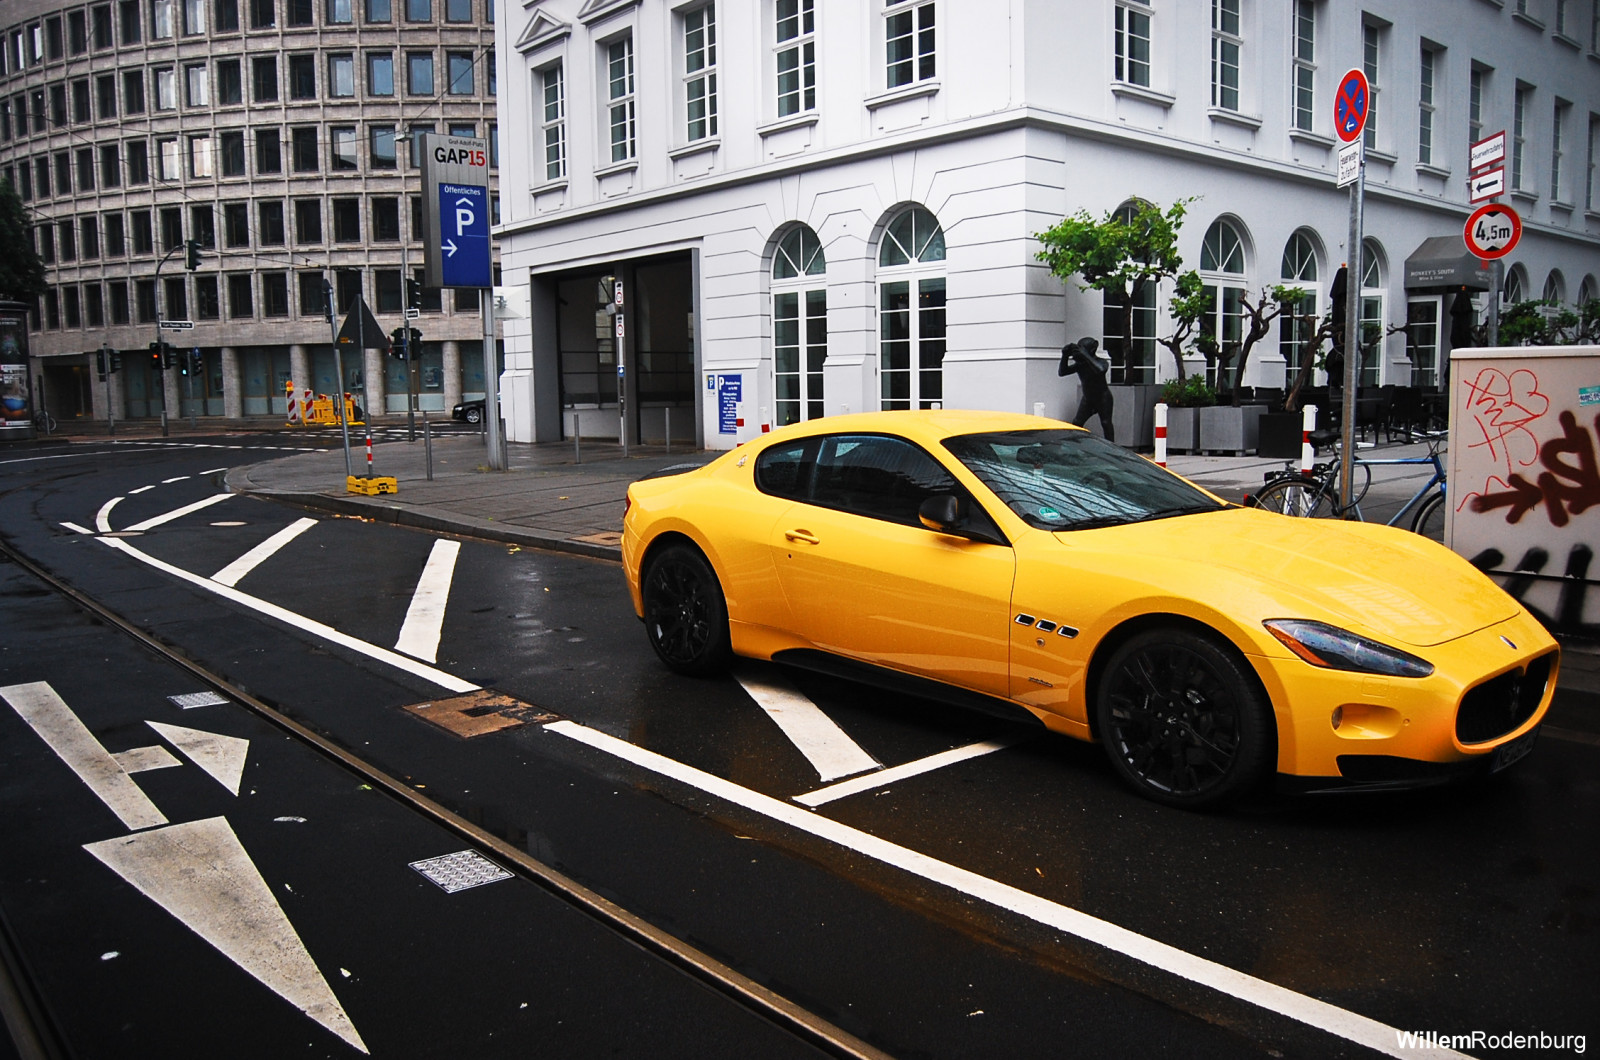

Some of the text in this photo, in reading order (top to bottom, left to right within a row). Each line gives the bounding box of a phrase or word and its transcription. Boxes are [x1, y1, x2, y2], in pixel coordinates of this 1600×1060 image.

[434, 147, 485, 166] GAP15
[444, 185, 481, 196] Öffentliches
[456, 208, 475, 236] P
[1475, 220, 1510, 241] 4,5m
